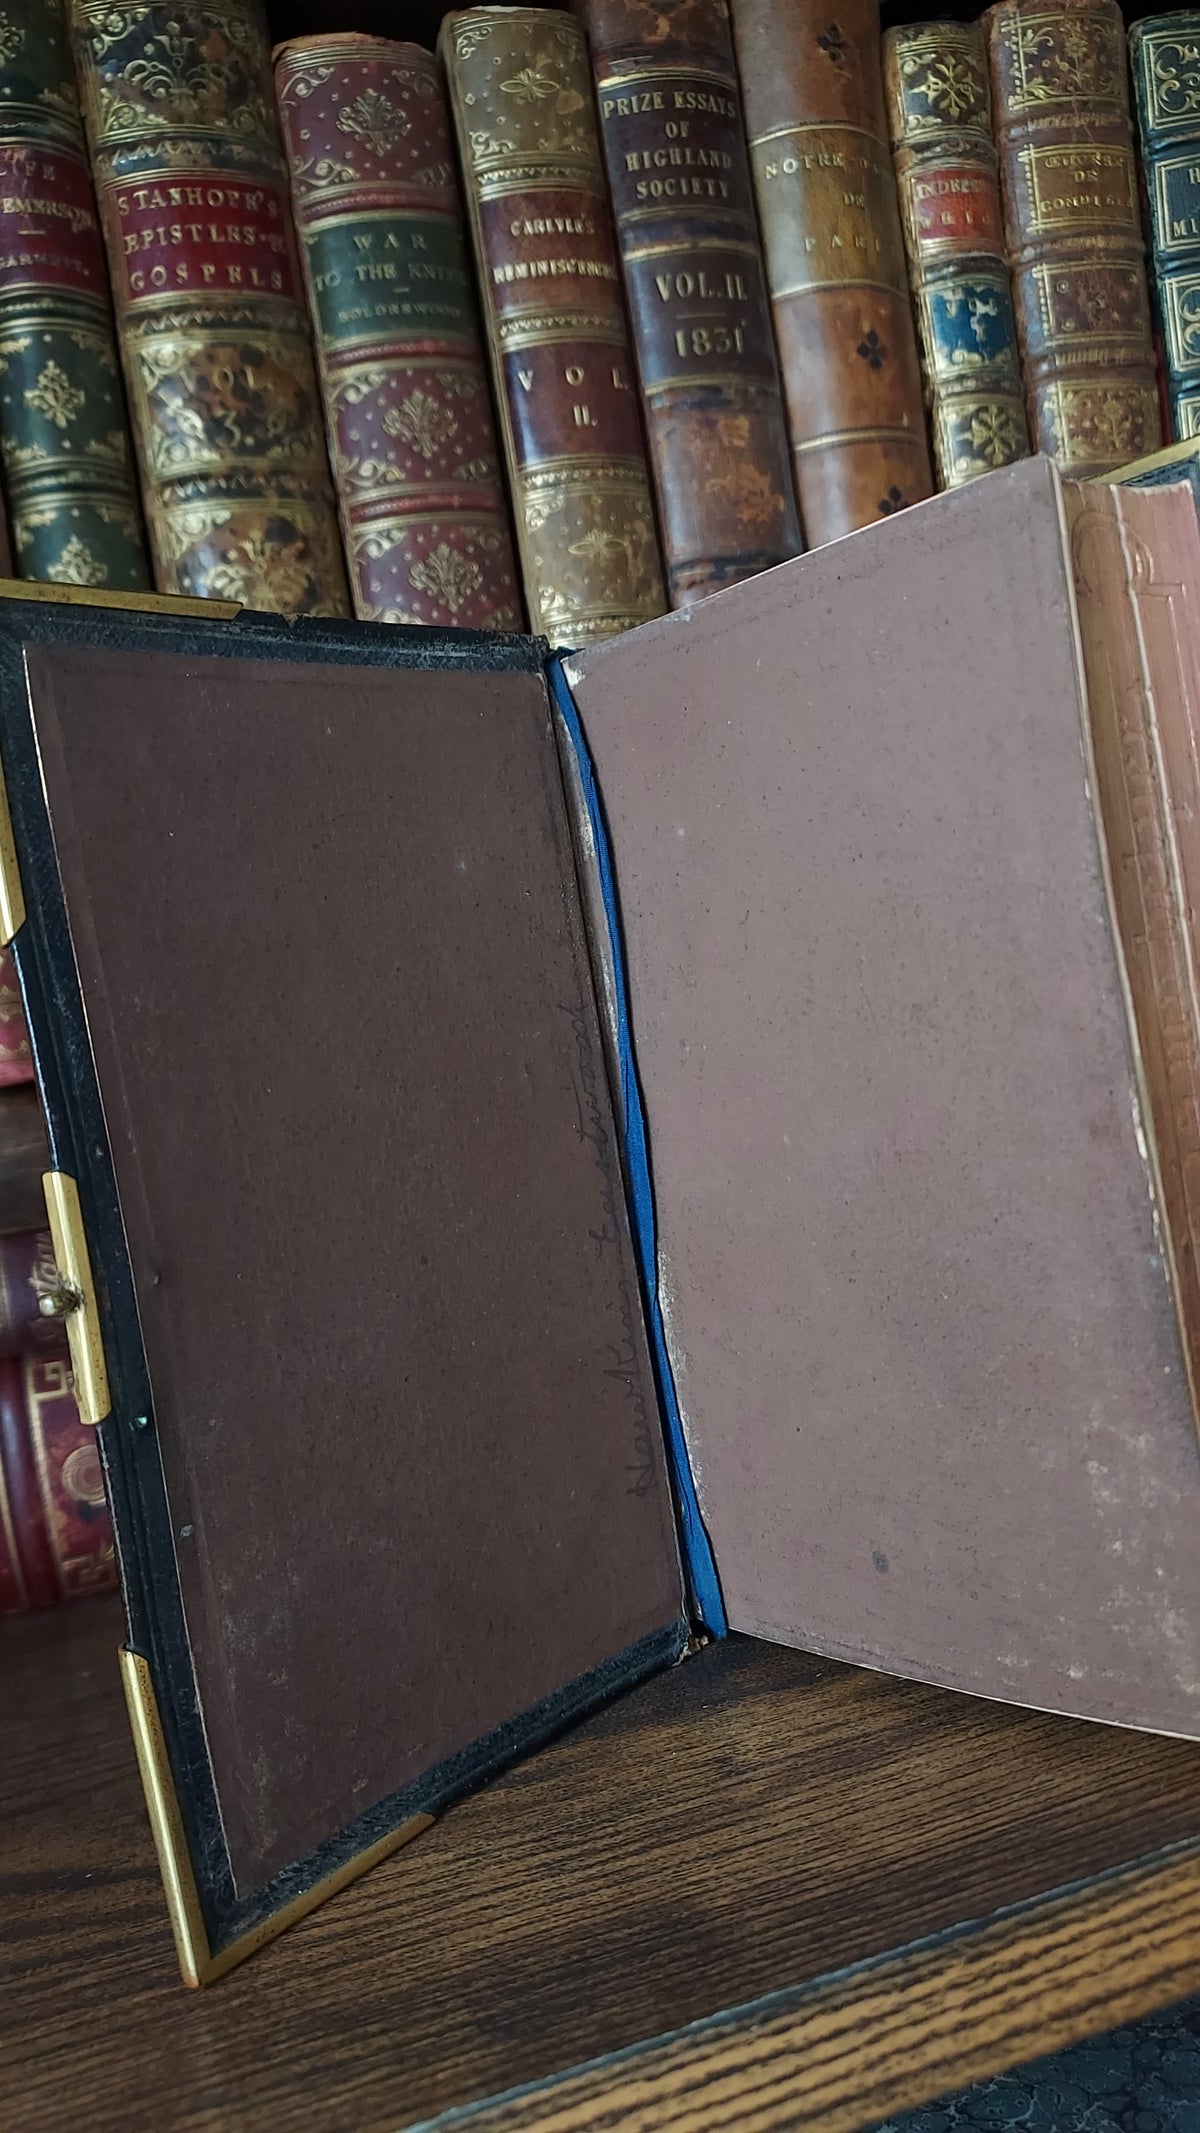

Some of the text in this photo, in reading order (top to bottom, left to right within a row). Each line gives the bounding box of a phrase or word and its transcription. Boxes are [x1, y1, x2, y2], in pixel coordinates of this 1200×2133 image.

[602, 91, 736, 119] PRIZE ESSAYS
[665, 121, 691, 139] OF
[625, 149, 733, 172] HIGHLAND
[117, 186, 279, 218] STANHOPE'S
[636, 178, 730, 200] SOCIETY
[123, 224, 257, 255] EPISTLES
[510, 215, 594, 237] CARLYLE'S
[352, 232, 428, 251] WAR
[129, 262, 284, 291] GOSPELS
[315, 268, 343, 293] TO
[355, 263, 398, 283] THE
[655, 271, 724, 304] VOL.
[675, 325, 744, 358] 1831
[517, 365, 629, 392] VOL.
